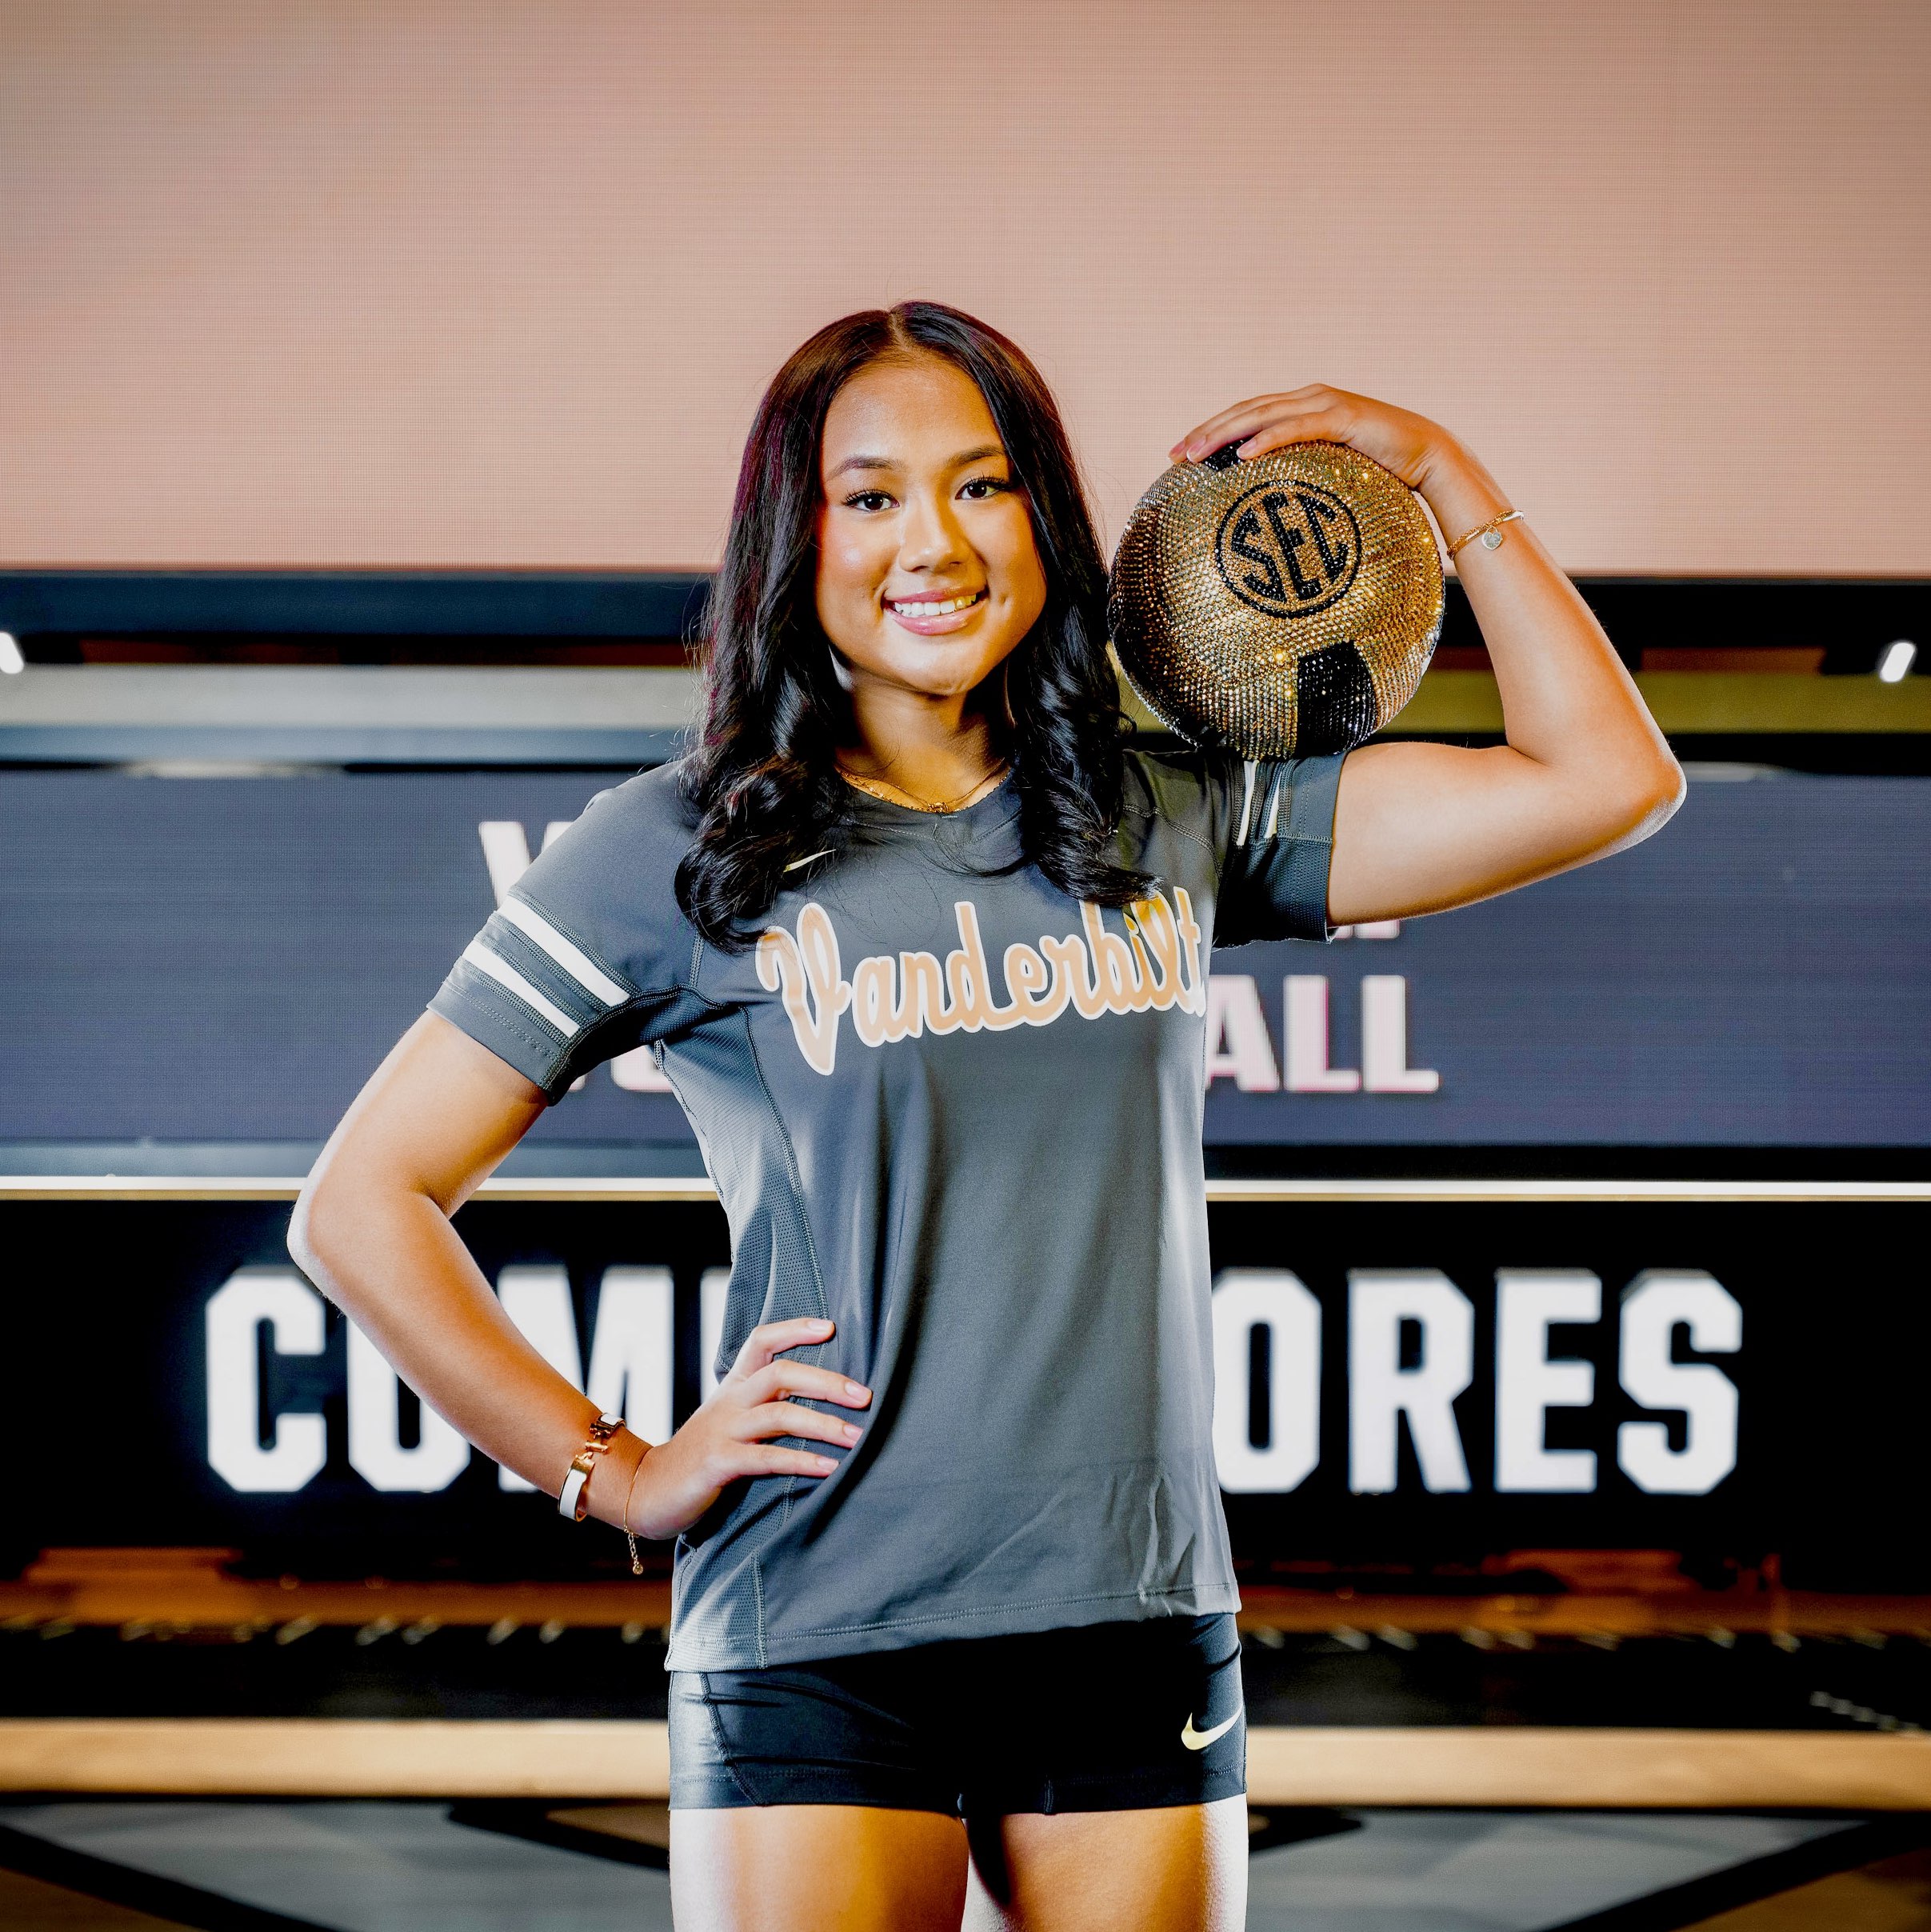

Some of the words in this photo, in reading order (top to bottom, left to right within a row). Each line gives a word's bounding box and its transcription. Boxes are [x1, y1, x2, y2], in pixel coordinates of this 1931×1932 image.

[1230, 491, 1349, 604] SEC
[755, 886, 1207, 1076] Vanderbilt
[206, 1266, 1743, 1494] COMORES
